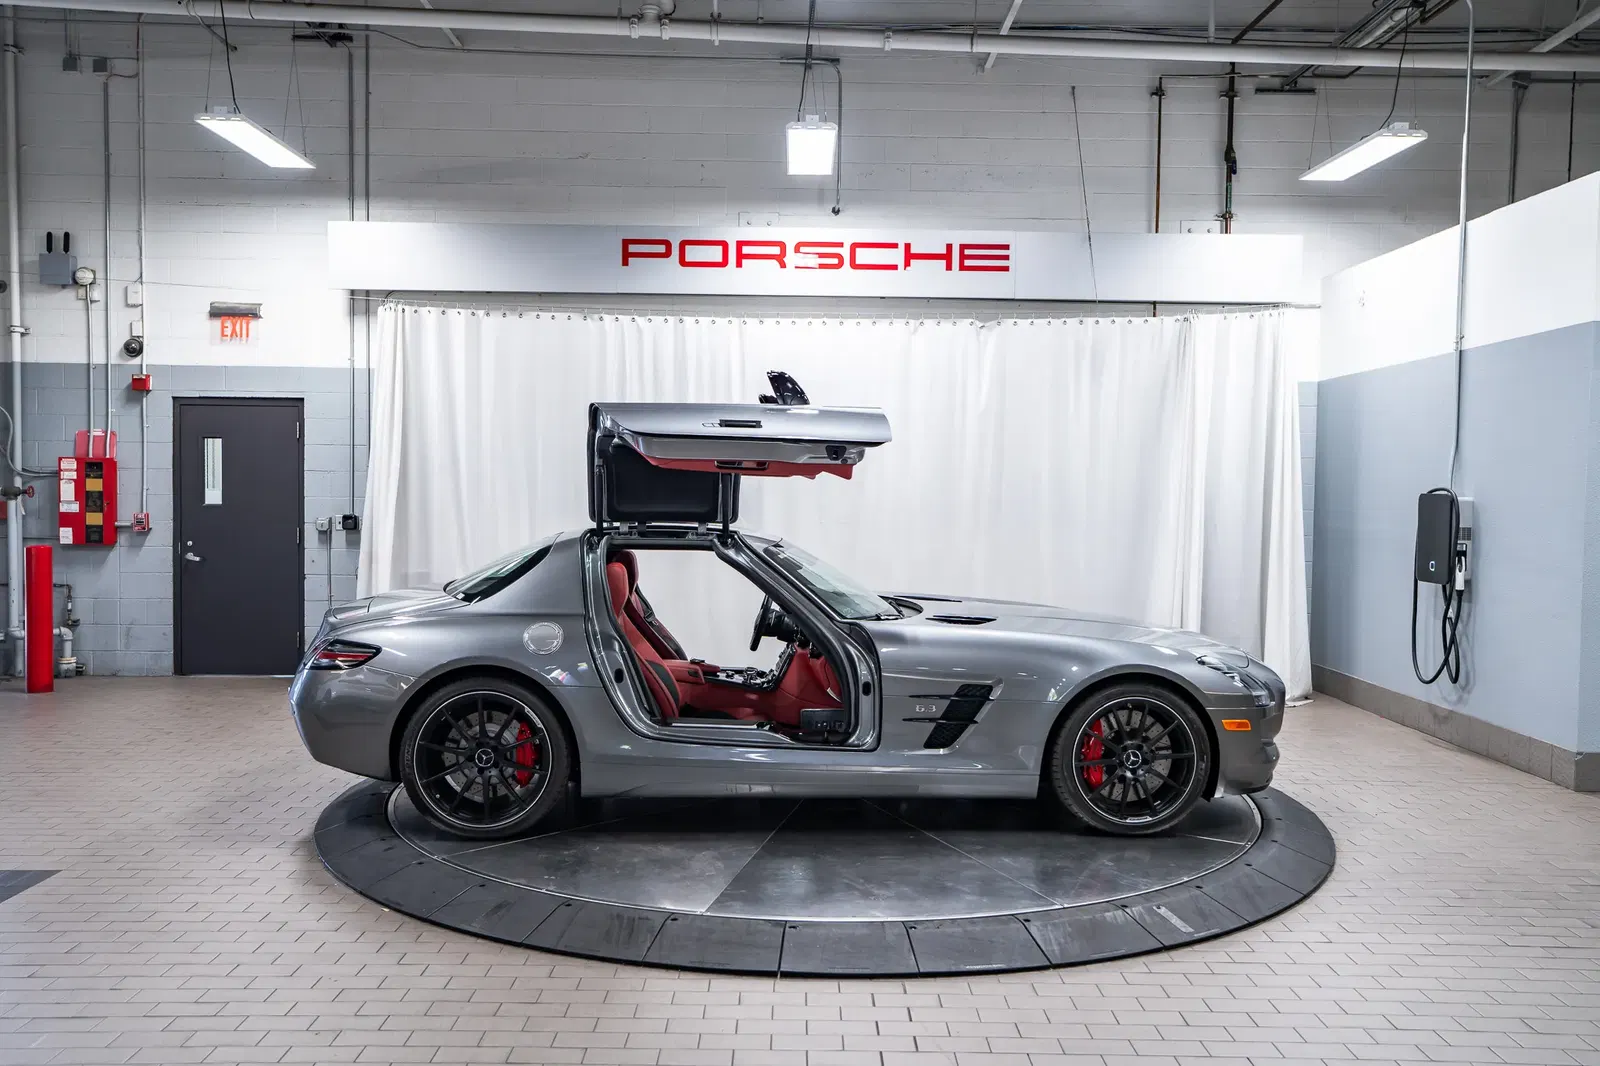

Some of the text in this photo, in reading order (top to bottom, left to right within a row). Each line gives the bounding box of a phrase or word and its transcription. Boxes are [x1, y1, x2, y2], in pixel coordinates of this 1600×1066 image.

[621, 238, 1010, 272] PORSCHE
[221, 316, 252, 338] EXIT
[915, 704, 937, 712] 6.3
